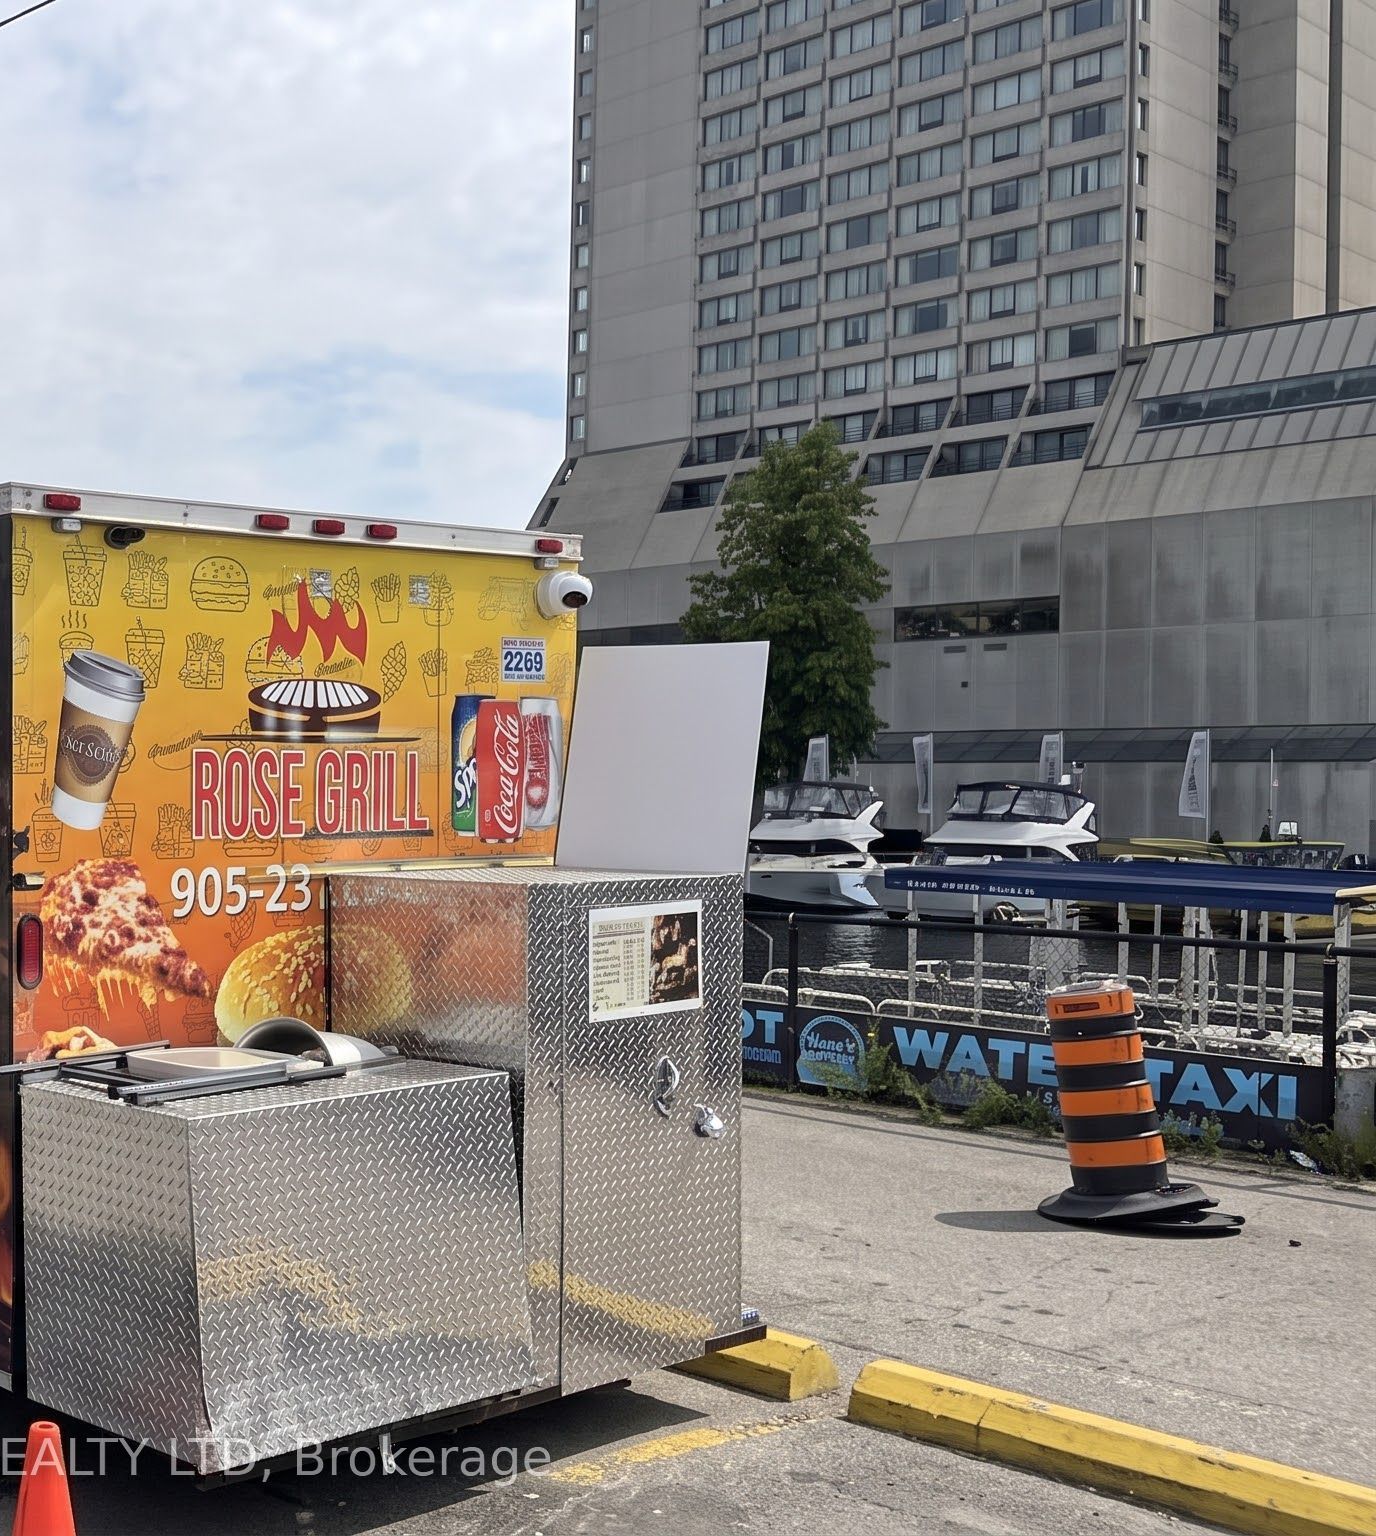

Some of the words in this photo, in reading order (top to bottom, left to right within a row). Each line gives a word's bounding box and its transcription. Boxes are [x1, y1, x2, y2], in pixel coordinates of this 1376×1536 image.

[504, 651, 543, 672] 2269
[192, 747, 306, 841] ROSE
[315, 749, 429, 836] GRILL
[170, 863, 325, 918] 905-23
[892, 1026, 1059, 1087] WATE
[1144, 1057, 1297, 1121] TAXI
